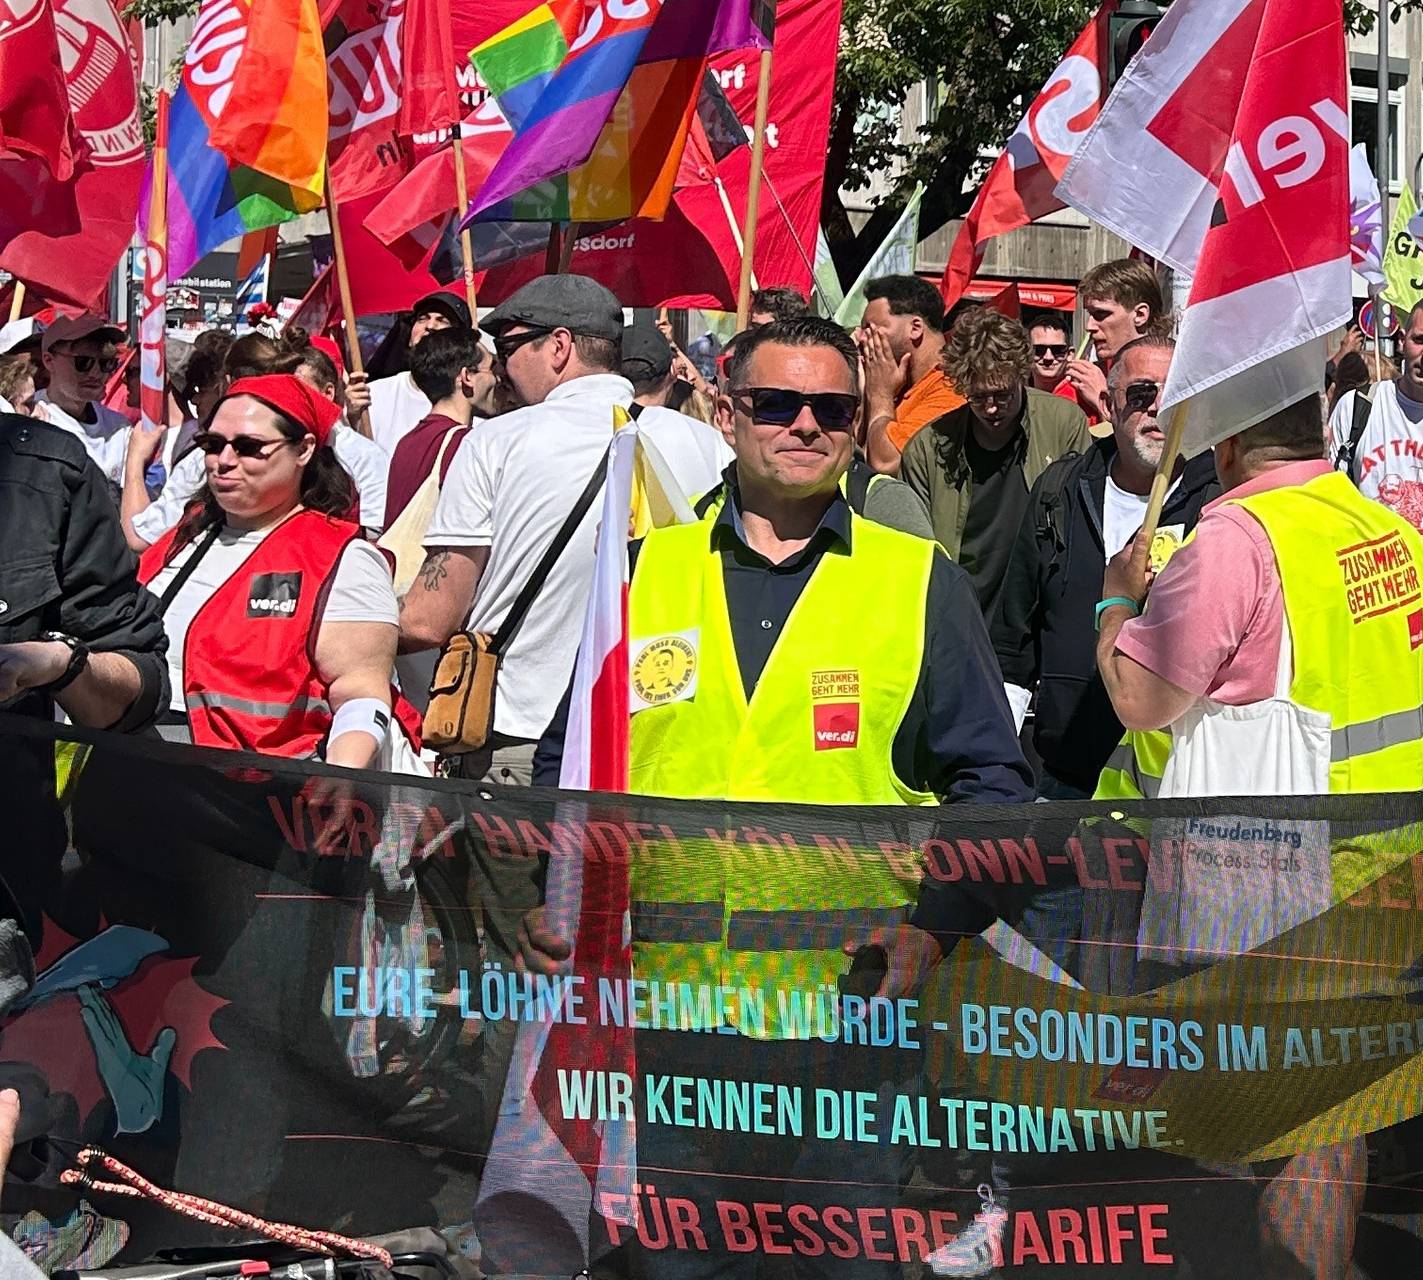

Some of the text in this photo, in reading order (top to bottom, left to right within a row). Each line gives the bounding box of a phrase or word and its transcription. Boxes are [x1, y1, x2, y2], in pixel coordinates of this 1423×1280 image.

[1338, 537, 1413, 586] ZUSAMMEN
[250, 598, 297, 613] ver.di
[1346, 565, 1421, 615] GEHT MEHR
[811, 673, 859, 685] ZUSAMMEN
[811, 684, 860, 696] GEHT MEHR
[816, 731, 856, 743] ver.di
[1187, 817, 1302, 848] Freudenberg
[333, 965, 438, 1020] EURE
[460, 961, 589, 1026] LÖHNE
[600, 977, 767, 1039] NEHMEN
[776, 975, 920, 1050] WÜRDE
[961, 1002, 1206, 1073] BESONDERS
[1217, 1023, 1270, 1073] IM
[556, 1068, 1185, 1154] WIR KENNEN DIE ALTERNATIVE.
[599, 1183, 1174, 1270] FÜR BESSERE TARIFE
